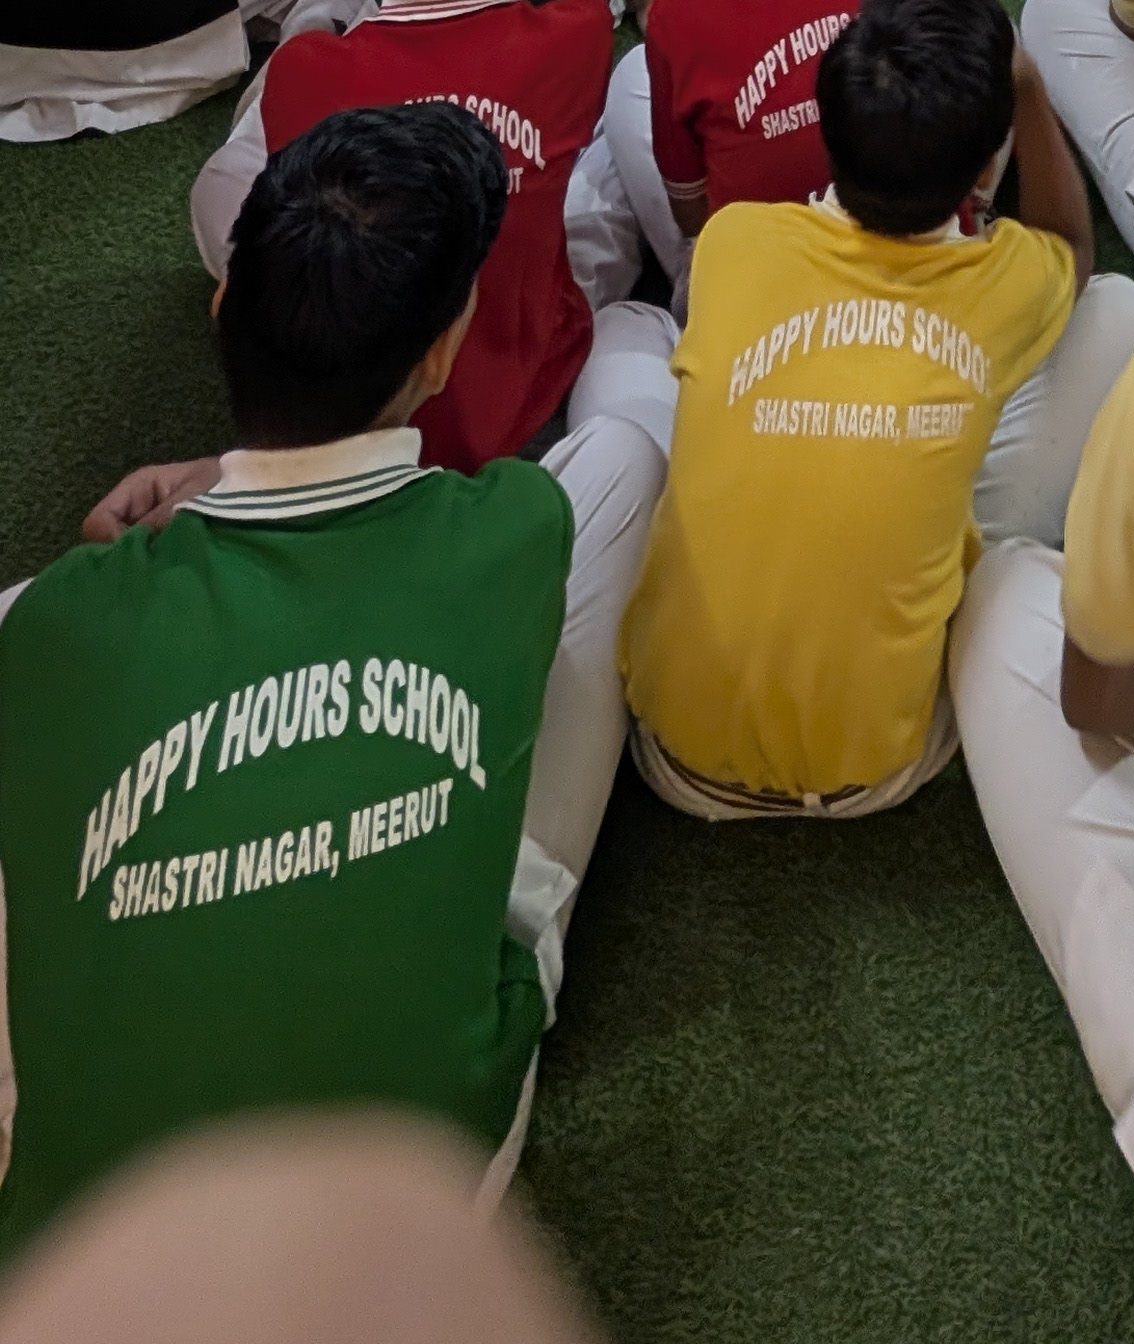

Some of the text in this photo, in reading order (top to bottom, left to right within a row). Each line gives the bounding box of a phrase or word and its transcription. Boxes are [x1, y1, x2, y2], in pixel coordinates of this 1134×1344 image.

[734, 38, 790, 130] HAPPY
[761, 98, 820, 140] SHASTRI
[465, 94, 547, 171] SCHOOL
[727, 306, 820, 408] HAPPY
[822, 298, 906, 349] HOURS
[753, 399, 975, 446] SHASTRI NAGAR, MEERUT
[76, 657, 487, 902] HAPPY HOURS SCHOOL
[108, 777, 454, 923] SHASTRI NAGAR, MEERUT
